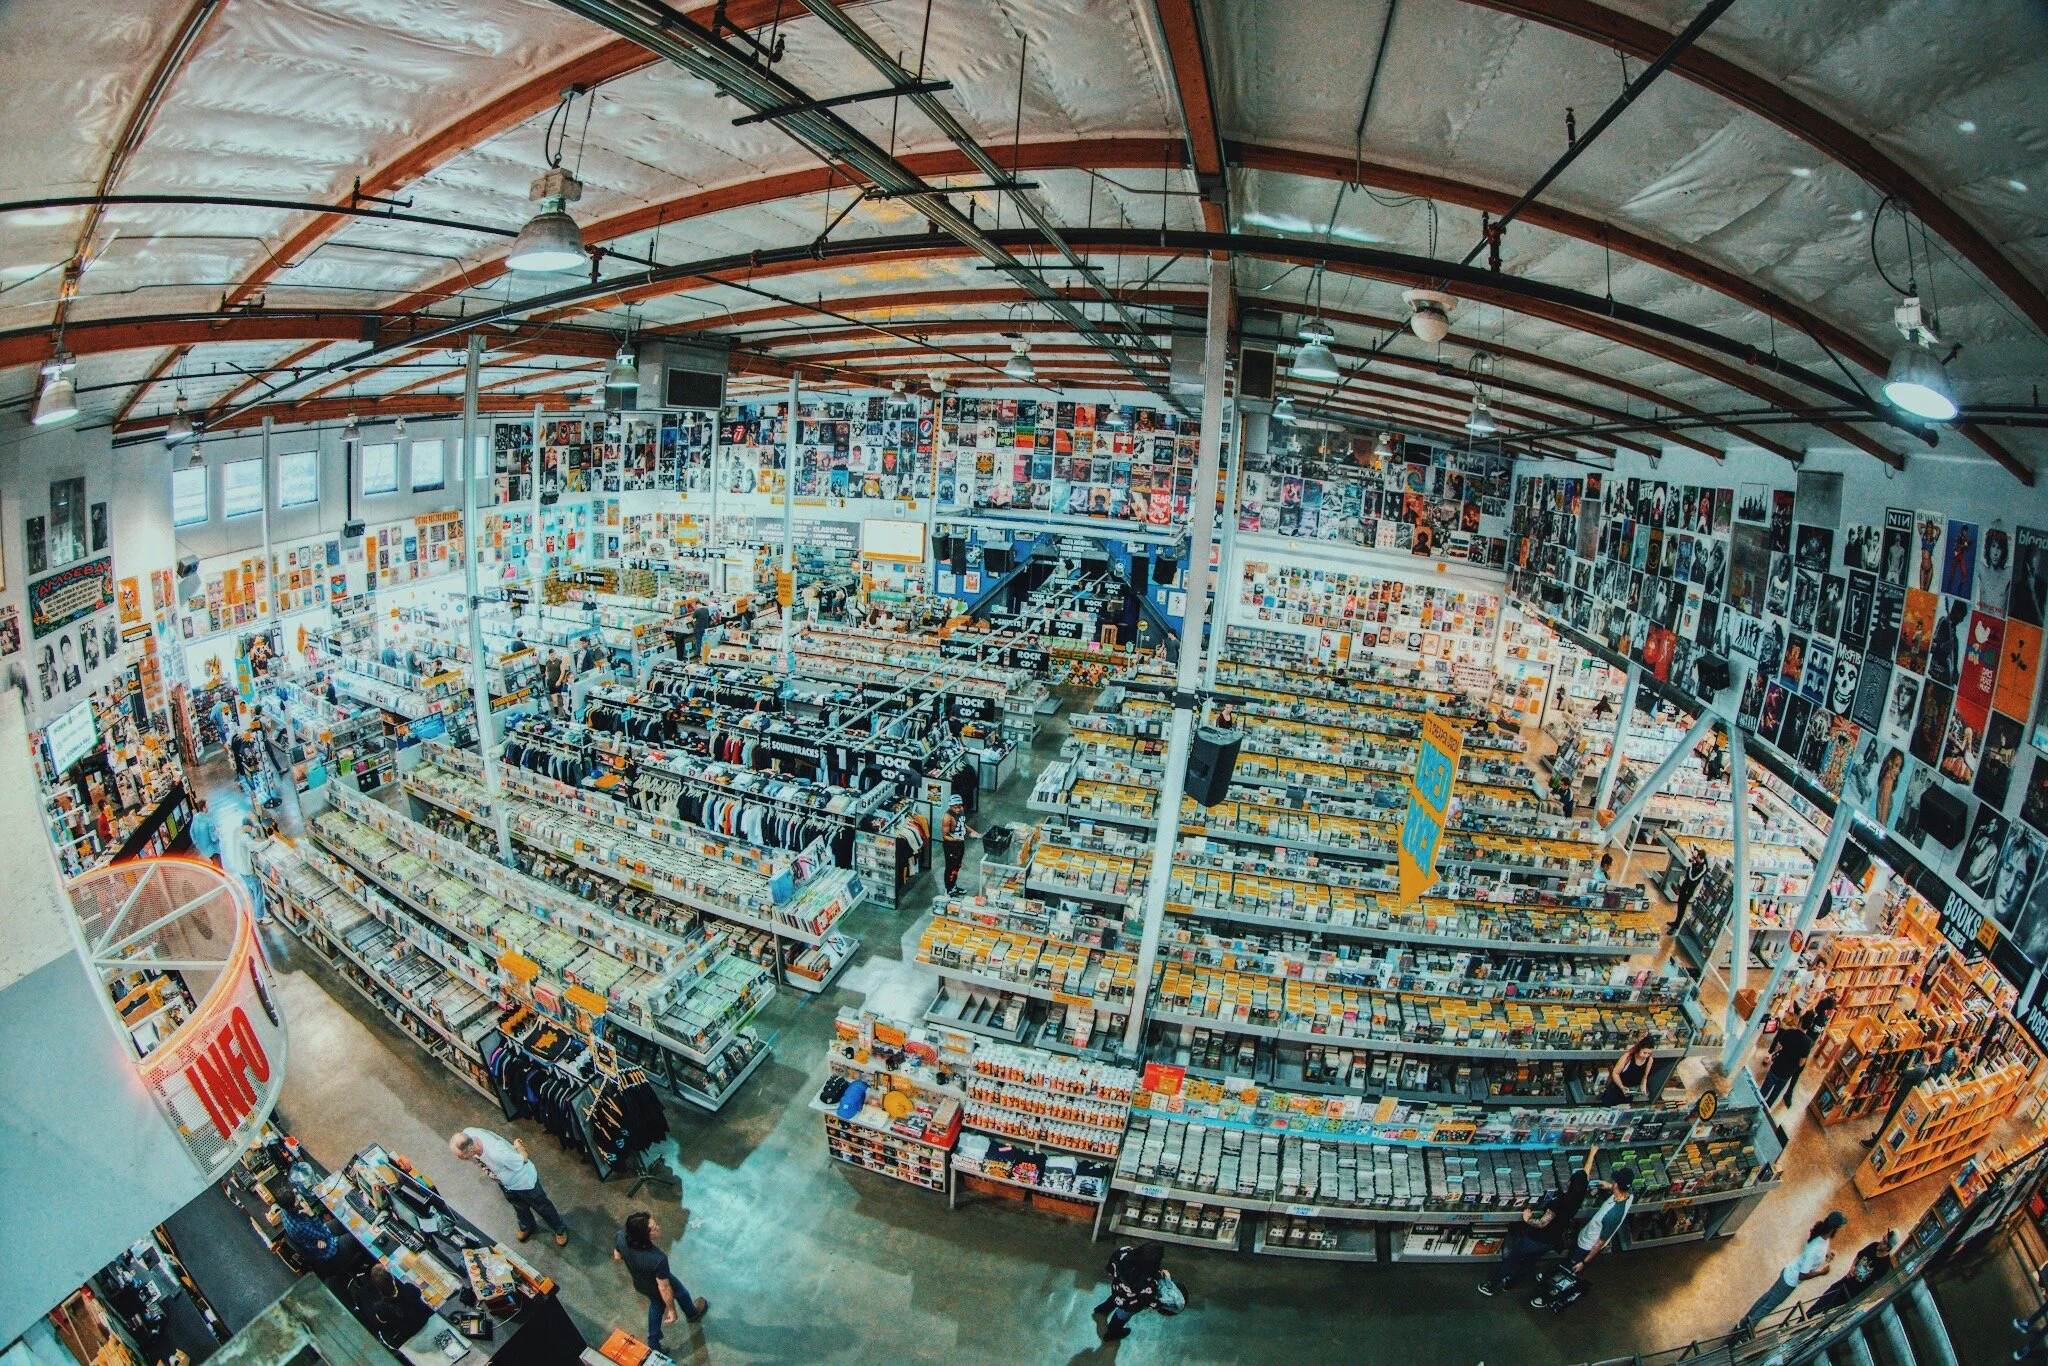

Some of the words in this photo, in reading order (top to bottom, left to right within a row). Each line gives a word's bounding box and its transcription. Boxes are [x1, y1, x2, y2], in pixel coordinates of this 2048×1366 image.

[1151, 493, 1171, 504] FEAR
[38, 562, 105, 597] AMOEBA
[1084, 600, 1102, 608] ROCK
[1055, 622, 1076, 631] ROCK
[941, 644, 977, 657] T-SHIRTS
[1017, 651, 1041, 661] ROCK
[955, 696, 985, 709] ROCK
[771, 742, 820, 759] SOUNDTRACKS
[836, 748, 847, 770] 1
[875, 754, 911, 771] ROCK
[1943, 891, 1983, 941] BOOKS
[1949, 925, 1967, 950] ZINES
[185, 1006, 270, 1141] INFO
